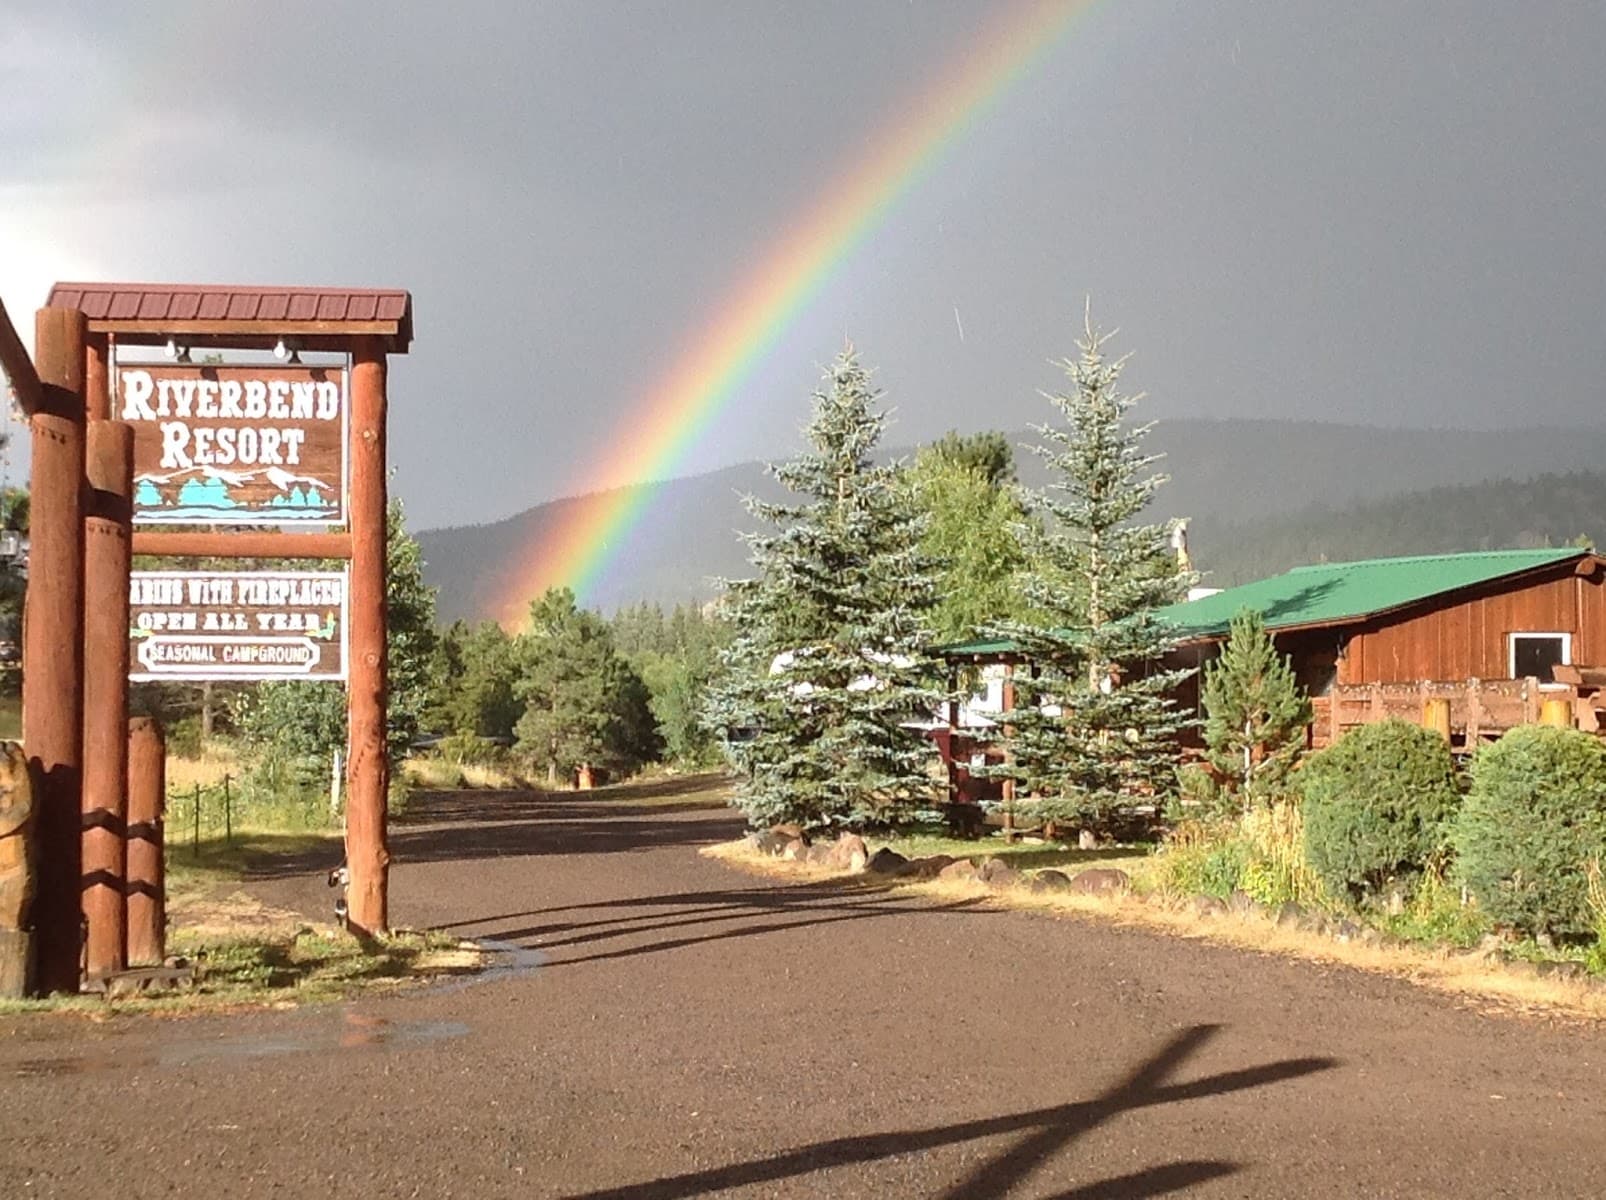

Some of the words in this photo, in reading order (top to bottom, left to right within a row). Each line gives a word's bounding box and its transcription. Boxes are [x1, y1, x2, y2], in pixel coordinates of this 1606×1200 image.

[121, 370, 339, 421] RIVERBEND
[159, 421, 305, 469] RESORT
[188, 579, 233, 605] WITH
[238, 579, 341, 605] FIREPLACES
[137, 612, 197, 630] OPEN
[205, 612, 248, 630] ALL
[256, 613, 320, 631] YEAR
[150, 644, 216, 662] SEASONAL
[223, 646, 310, 663] CAMPGROUND
